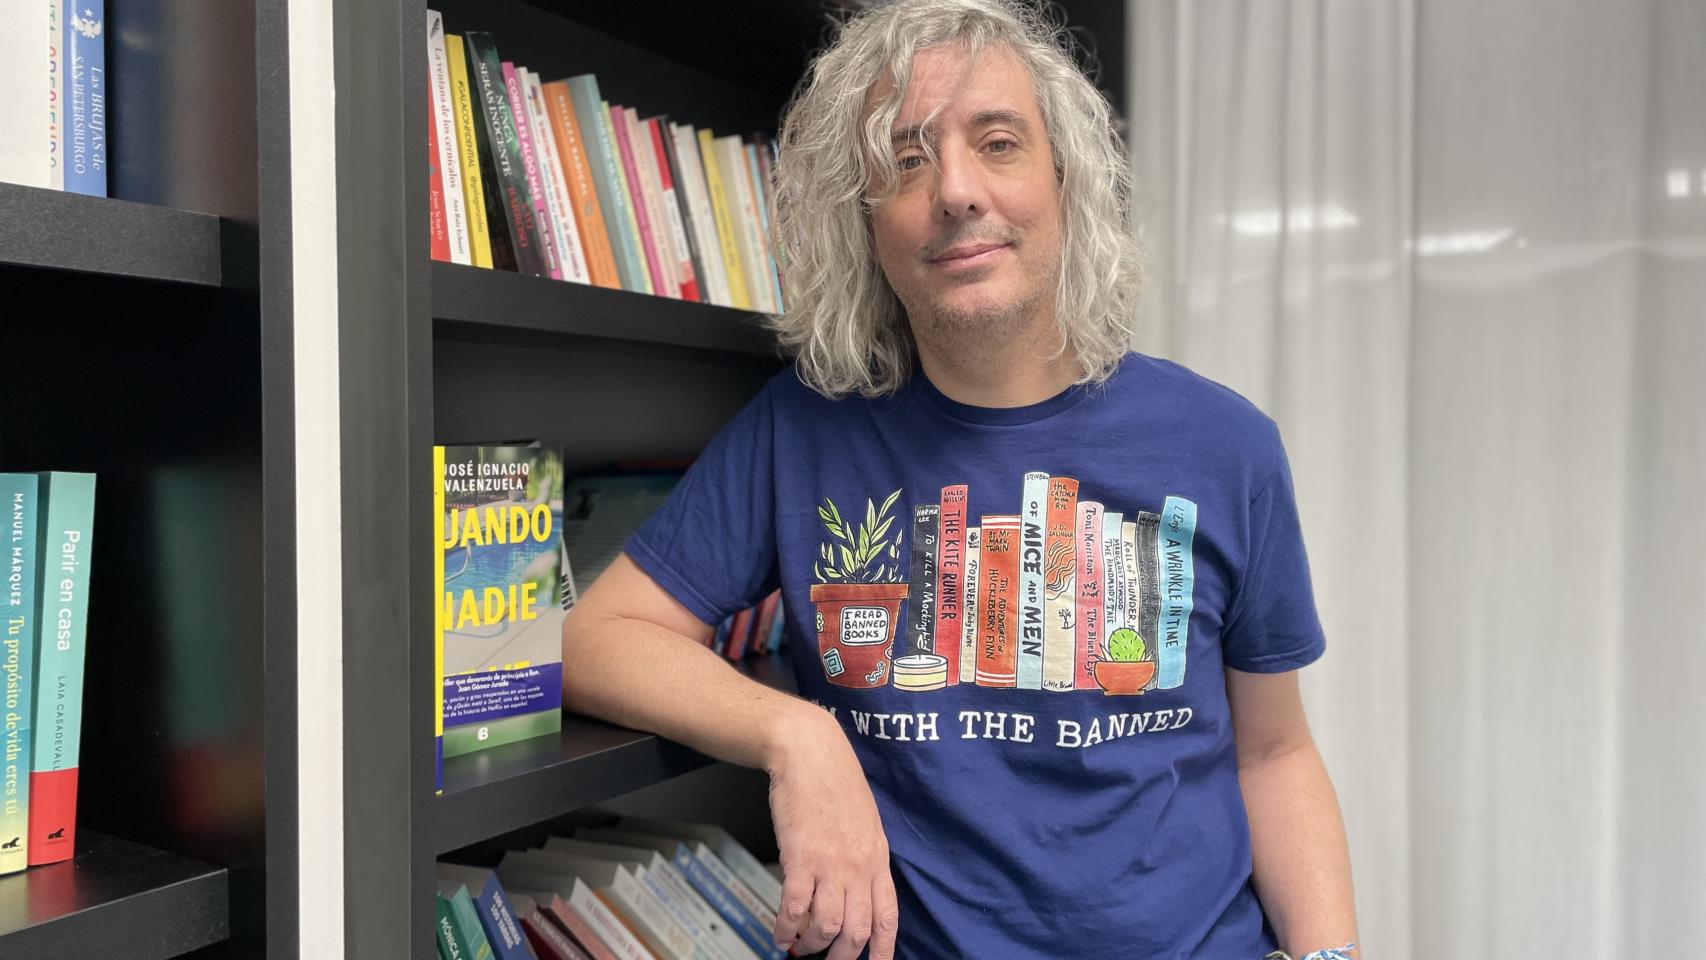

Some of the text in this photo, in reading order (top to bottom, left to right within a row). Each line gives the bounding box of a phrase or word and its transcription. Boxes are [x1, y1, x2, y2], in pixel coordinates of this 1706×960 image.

[509, 78, 524, 123] CORRER
[73, 84, 86, 174] PETERSBURGO
[88, 66, 104, 170] Las BRUJAS de
[496, 95, 513, 143] NUNCA
[518, 125, 529, 139] ES
[489, 106, 512, 176] INOCENTE
[521, 140, 536, 174] ALGO
[444, 478, 524, 492] VALENZUELA
[478, 463, 530, 476] IGNACIO
[1054, 482, 1067, 490] the
[13, 493, 24, 543] MANUEL
[925, 534, 935, 545] TO
[986, 543, 1010, 552] TWAIN
[1084, 507, 1097, 575] Toni Morrison
[1104, 539, 1113, 556] THE
[9, 548, 25, 606] MÁRQUEZ
[924, 552, 933, 576] KILL
[941, 510, 961, 620] THE KITE RUNNER
[1022, 501, 1043, 657] OF MICE AND MEN
[57, 530, 81, 651] Parir en casa
[966, 560, 978, 607] FOREVER
[999, 578, 1008, 593] THE
[1165, 538, 1184, 649] A WRINKLE IN TIME
[9, 616, 25, 635] Tu
[845, 620, 886, 630] BANNED
[855, 611, 882, 619] READ
[844, 630, 879, 640] BOOKS
[986, 635, 995, 660] FINN
[1084, 609, 1097, 677] The Bluest Eye
[3, 639, 22, 708] propósito
[57, 676, 67, 700] LAIA
[6, 713, 22, 729] de
[851, 707, 1193, 748] WITH THE BANNED
[6, 729, 22, 761] vida
[6, 765, 17, 796] eres
[440, 916, 459, 959] MÓNICA
